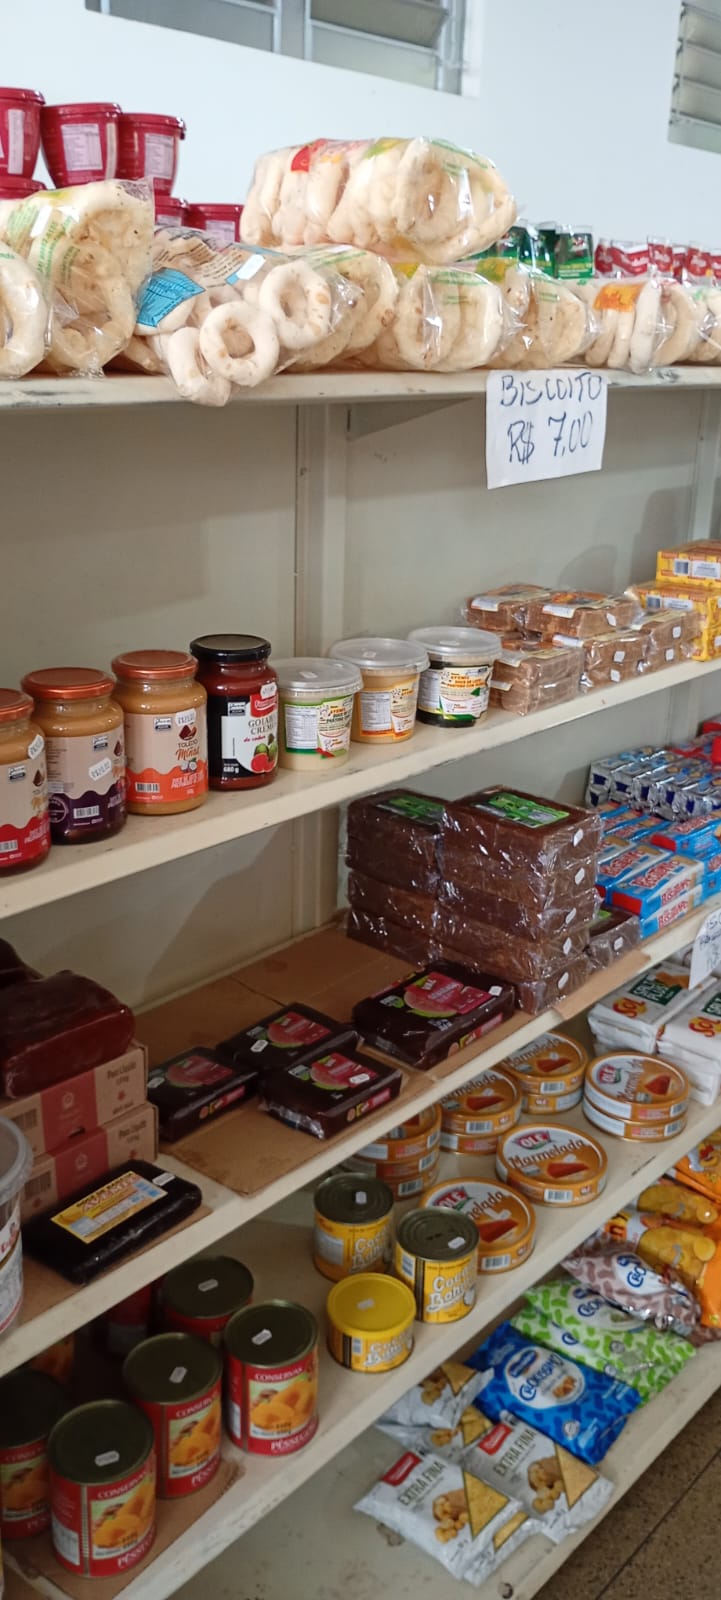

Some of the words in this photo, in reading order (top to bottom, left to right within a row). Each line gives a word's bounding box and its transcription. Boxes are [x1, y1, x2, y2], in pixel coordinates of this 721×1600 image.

[500, 371, 602, 407] BISCOITO
[507, 420, 535, 464] R$
[548, 411, 593, 457] 7,00
[508, 1139, 585, 1168] Marmelada
[493, 1448, 521, 1477] EXTRA
[515, 1429, 538, 1451] FINA
[398, 1476, 430, 1506] EXTRA
[424, 1461, 447, 1485] FINA
